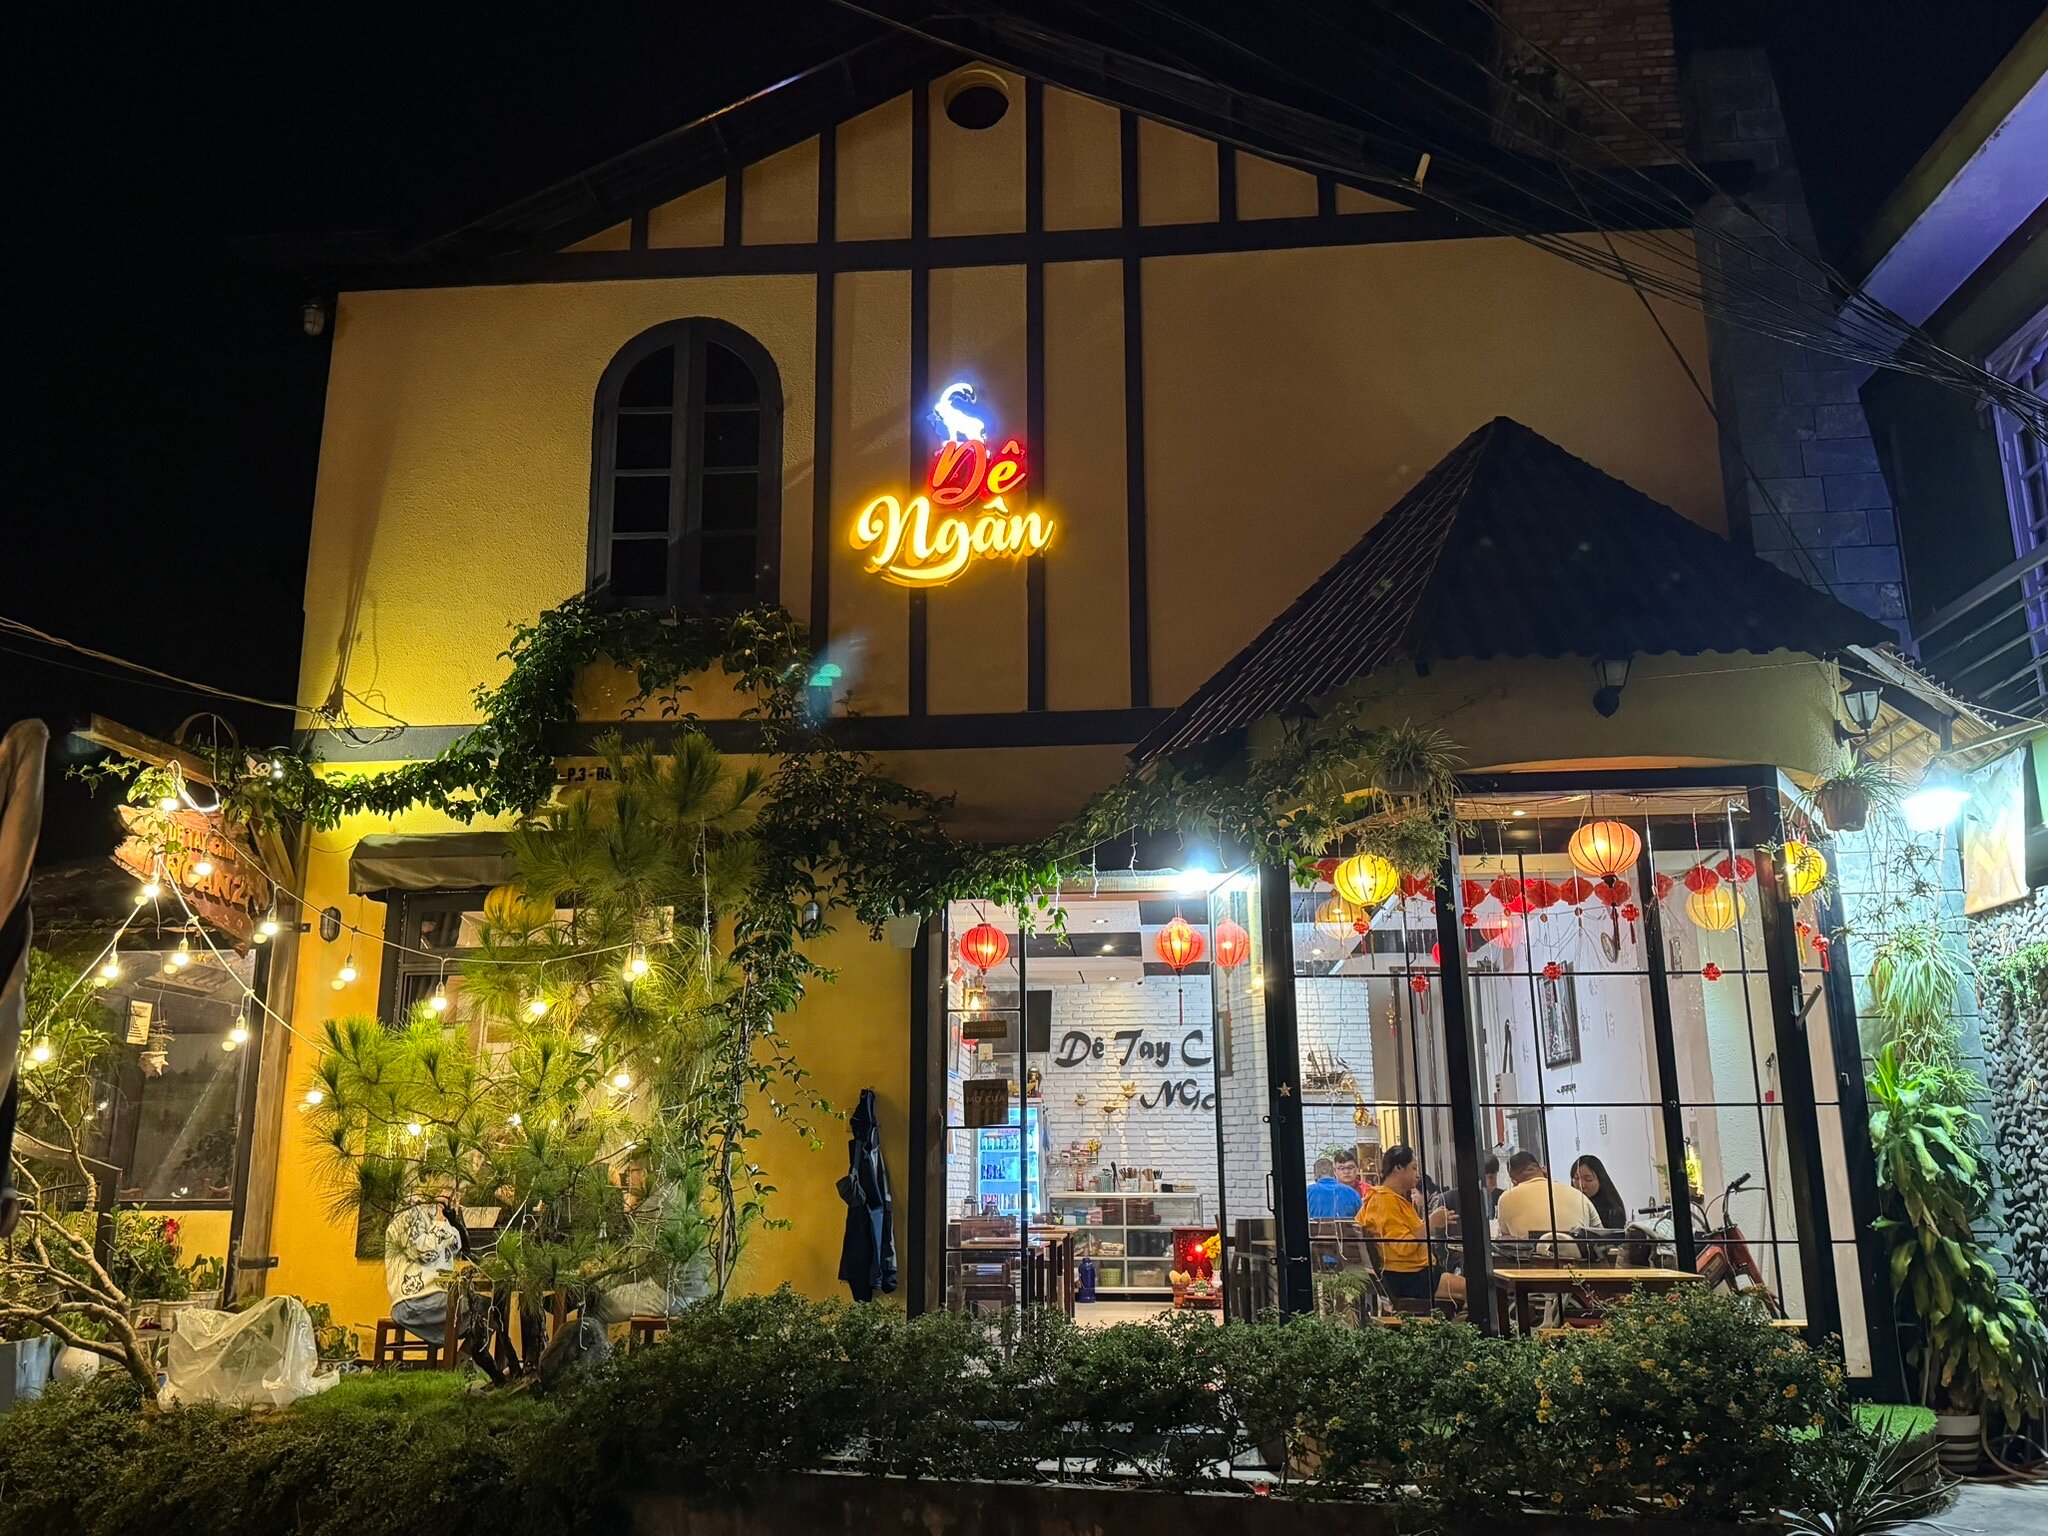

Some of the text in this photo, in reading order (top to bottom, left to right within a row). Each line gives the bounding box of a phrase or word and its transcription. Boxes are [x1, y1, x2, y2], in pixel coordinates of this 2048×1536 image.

[930, 440, 1026, 506] Dê
[855, 495, 1055, 581] Ngân
[1054, 1030, 1105, 1068] Dê
[1113, 1028, 1171, 1068] Tay
